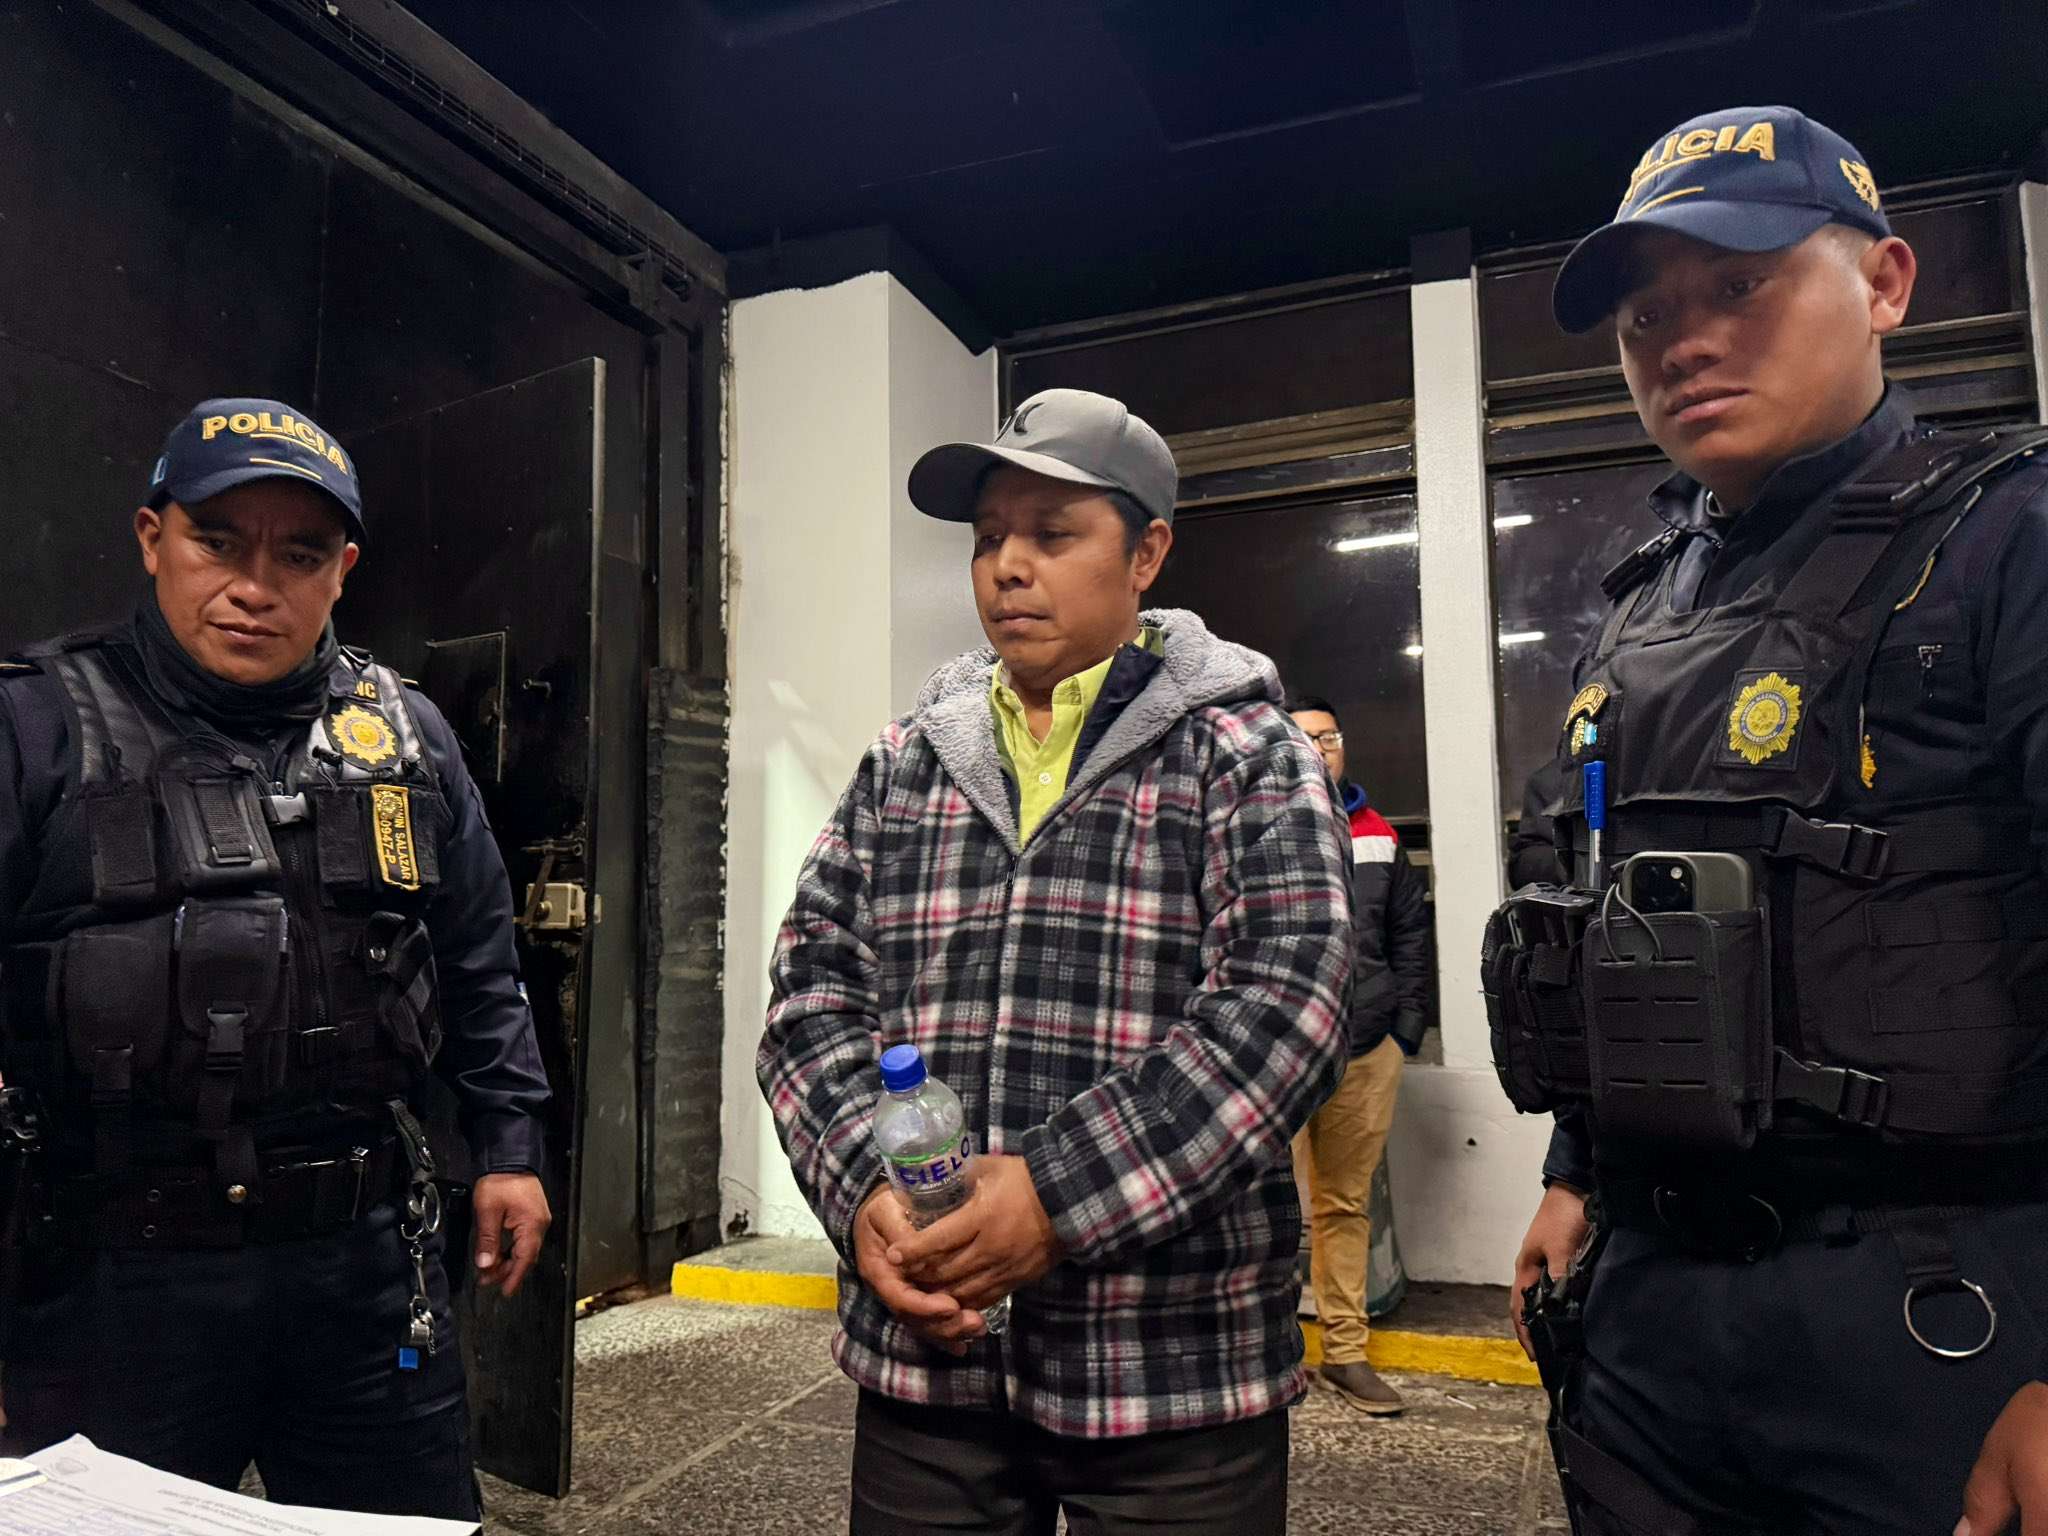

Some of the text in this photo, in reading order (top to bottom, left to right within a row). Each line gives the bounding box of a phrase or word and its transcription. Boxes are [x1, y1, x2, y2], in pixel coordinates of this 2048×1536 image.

[1624, 122, 1775, 203] LICIA
[202, 412, 348, 475] POLICIA
[380, 813, 397, 865] 0947-P
[394, 832, 412, 881] SALAZAR
[897, 1136, 970, 1185] CIELO
